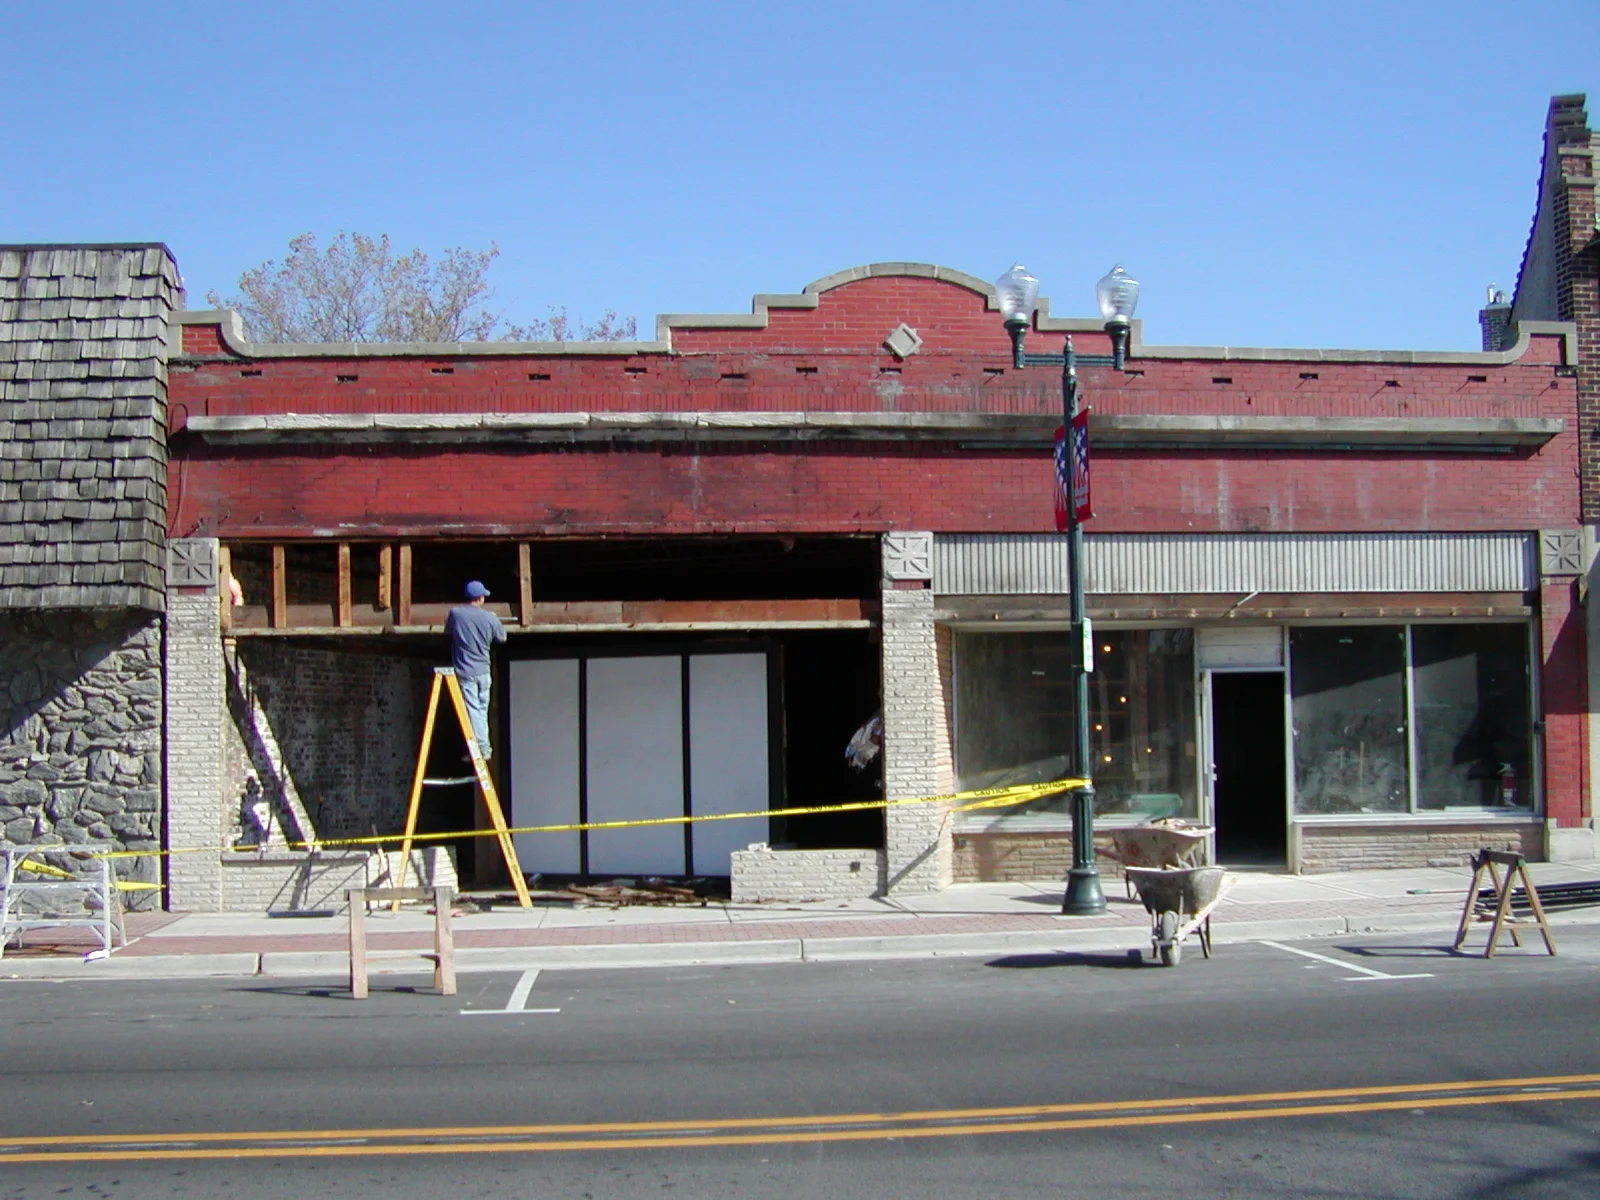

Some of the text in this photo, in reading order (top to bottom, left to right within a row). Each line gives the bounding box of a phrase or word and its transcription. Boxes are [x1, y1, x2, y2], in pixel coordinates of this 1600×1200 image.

[920, 793, 957, 802] CAUTION
[973, 787, 1010, 797] CAUTION
[1032, 782, 1067, 792] CAUTION
